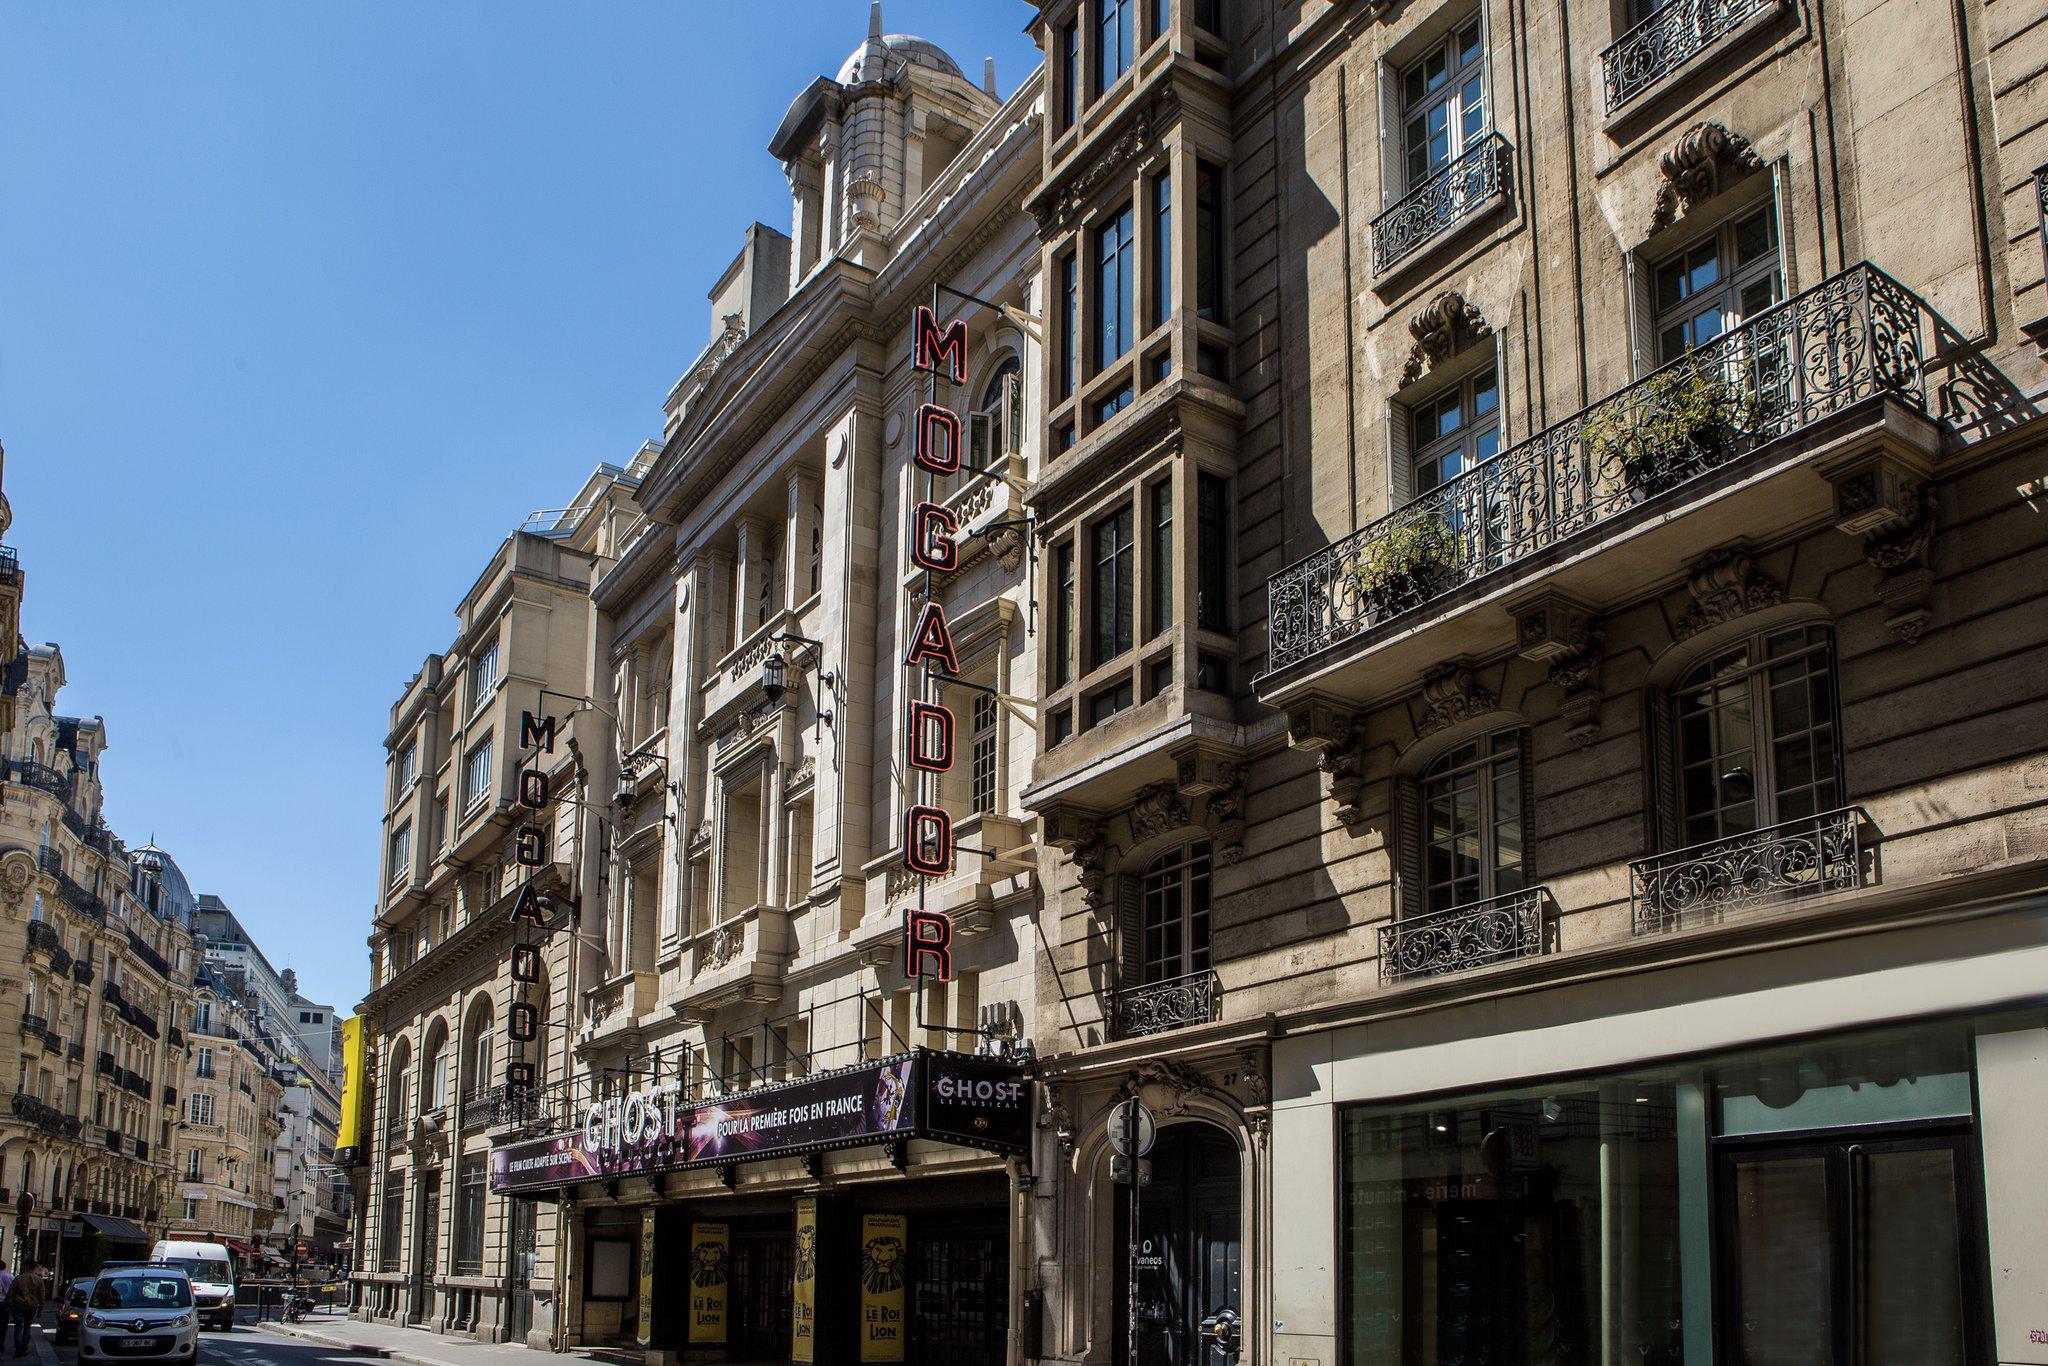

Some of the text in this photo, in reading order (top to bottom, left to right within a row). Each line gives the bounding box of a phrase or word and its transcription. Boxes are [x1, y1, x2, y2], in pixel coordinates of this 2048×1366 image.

[903, 305, 968, 984] MOGADOR
[937, 1076, 1021, 1101] GHOST
[1223, 1073, 1237, 1086] 27
[961, 1099, 1019, 1109] MUSICAL
[583, 1081, 681, 1154] GHOST
[717, 1094, 863, 1138] POUR LA PREMIÈRE FOIS EN FRANCE
[697, 1312, 720, 1326] LION
[866, 1306, 900, 1323] LE ROI
[870, 1323, 896, 1341] LION
